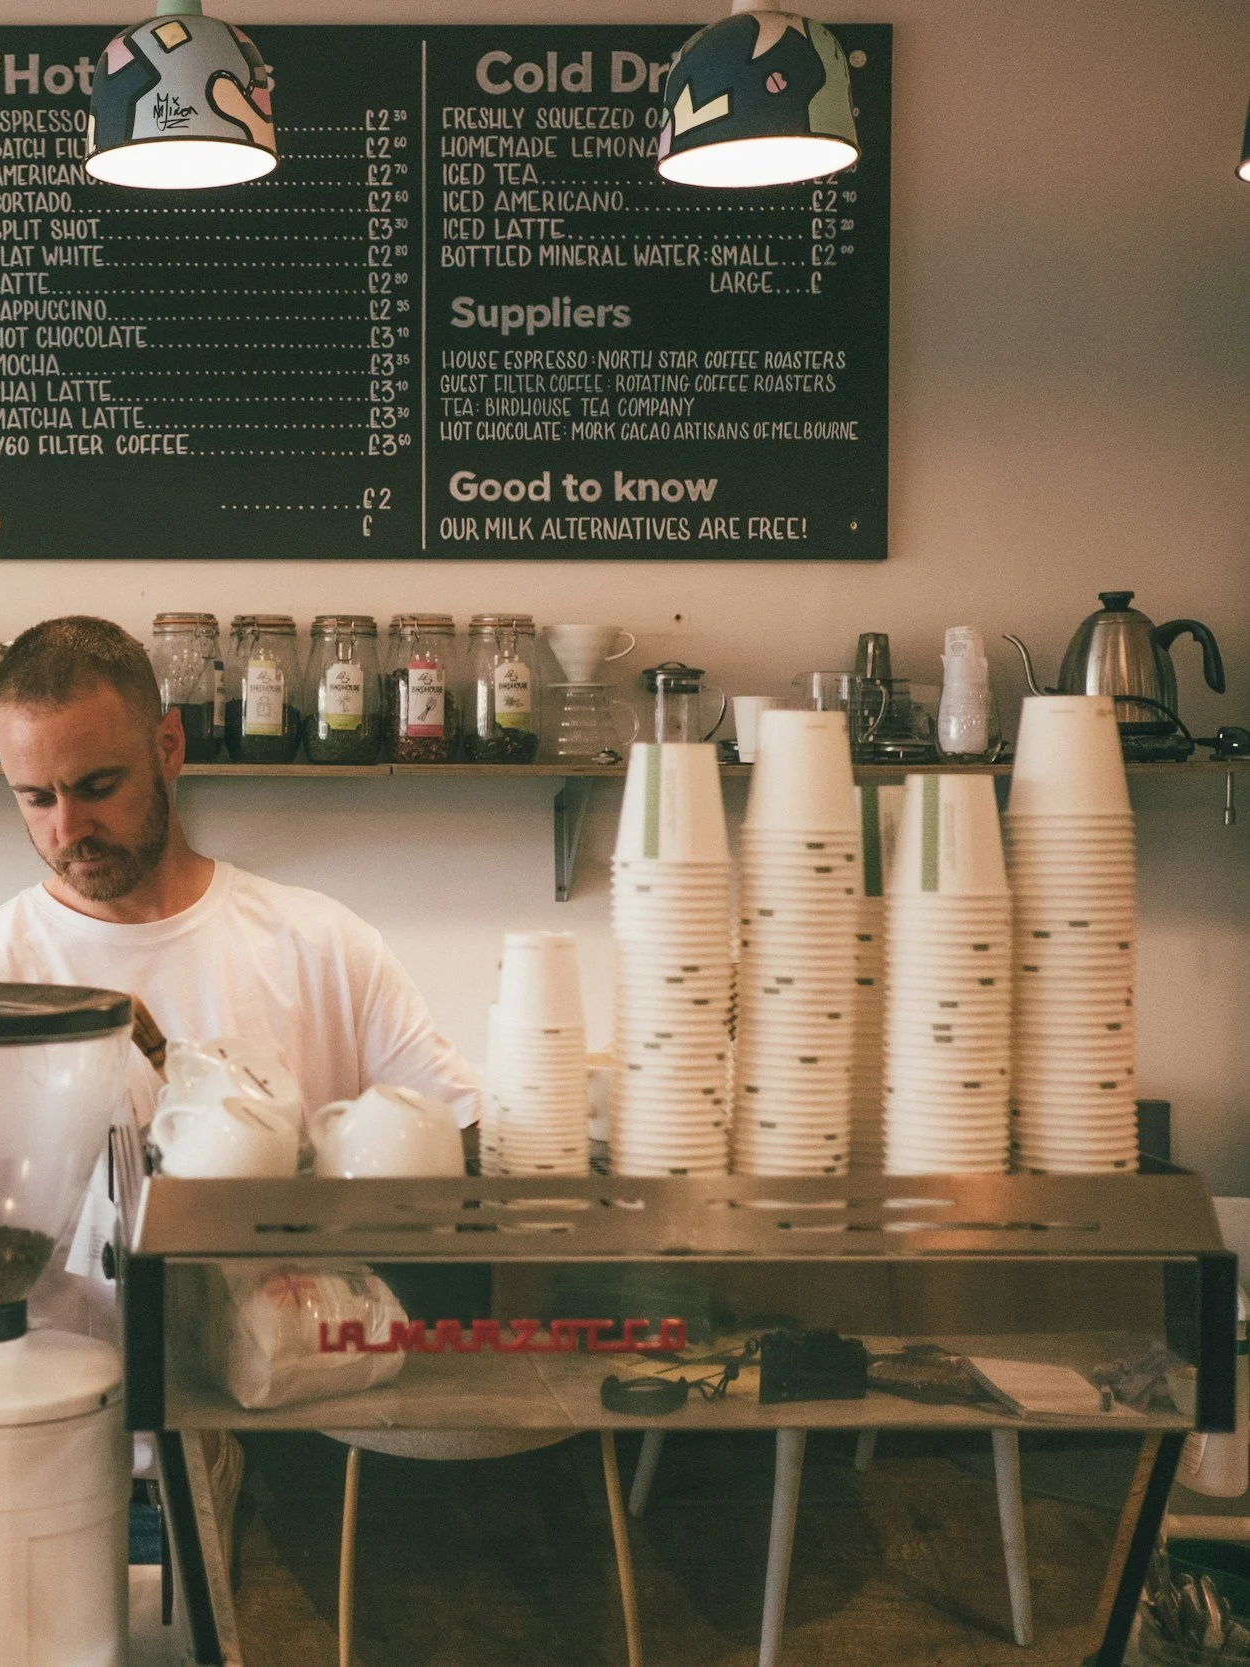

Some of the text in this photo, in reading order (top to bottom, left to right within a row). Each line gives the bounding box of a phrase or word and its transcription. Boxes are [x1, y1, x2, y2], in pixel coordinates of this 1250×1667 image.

[4, 54, 96, 95] Hot
[476, 50, 592, 94] Cold
[443, 107, 634, 129] FRESHLY SQUEEZED
[442, 136, 556, 157] HOMEMADE
[443, 163, 538, 185] ICED TEA
[443, 190, 623, 212] ICED AMERICANO
[50, 219, 100, 240] SHOT
[444, 218, 565, 240] ICED LATTE
[42, 245, 104, 267] WHITE
[441, 245, 532, 267] BOTTLED
[542, 244, 626, 266] MINERAL
[710, 271, 773, 293] LARGE
[451, 296, 631, 335] Suppliers
[36, 326, 147, 348] CHOCOLATE
[442, 350, 499, 369] HOUSE
[659, 350, 698, 368] STAR
[705, 351, 759, 369] COFFEE
[764, 351, 845, 369] ROASTERS
[47, 380, 111, 402] LATTE
[440, 374, 488, 393] GUEST
[494, 374, 546, 393] FILTER
[616, 374, 690, 392] ROTATING
[695, 374, 749, 392] COFFEE
[754, 374, 836, 392] ROASTERS
[82, 407, 145, 429] LATTE
[485, 397, 571, 417] BIRDHOUSE
[581, 397, 609, 417] TEA
[618, 397, 694, 417] COMPANY
[440, 421, 472, 440] HOT
[572, 422, 615, 440] MORK
[621, 422, 670, 440] CACAO
[674, 422, 749, 440] ARTISANS
[39, 435, 103, 455] FILTER
[116, 434, 189, 455] COFFEE
[450, 471, 717, 502] Good to know
[440, 517, 806, 540] OUR MILK ALTERNATIVES ARE FREE!
